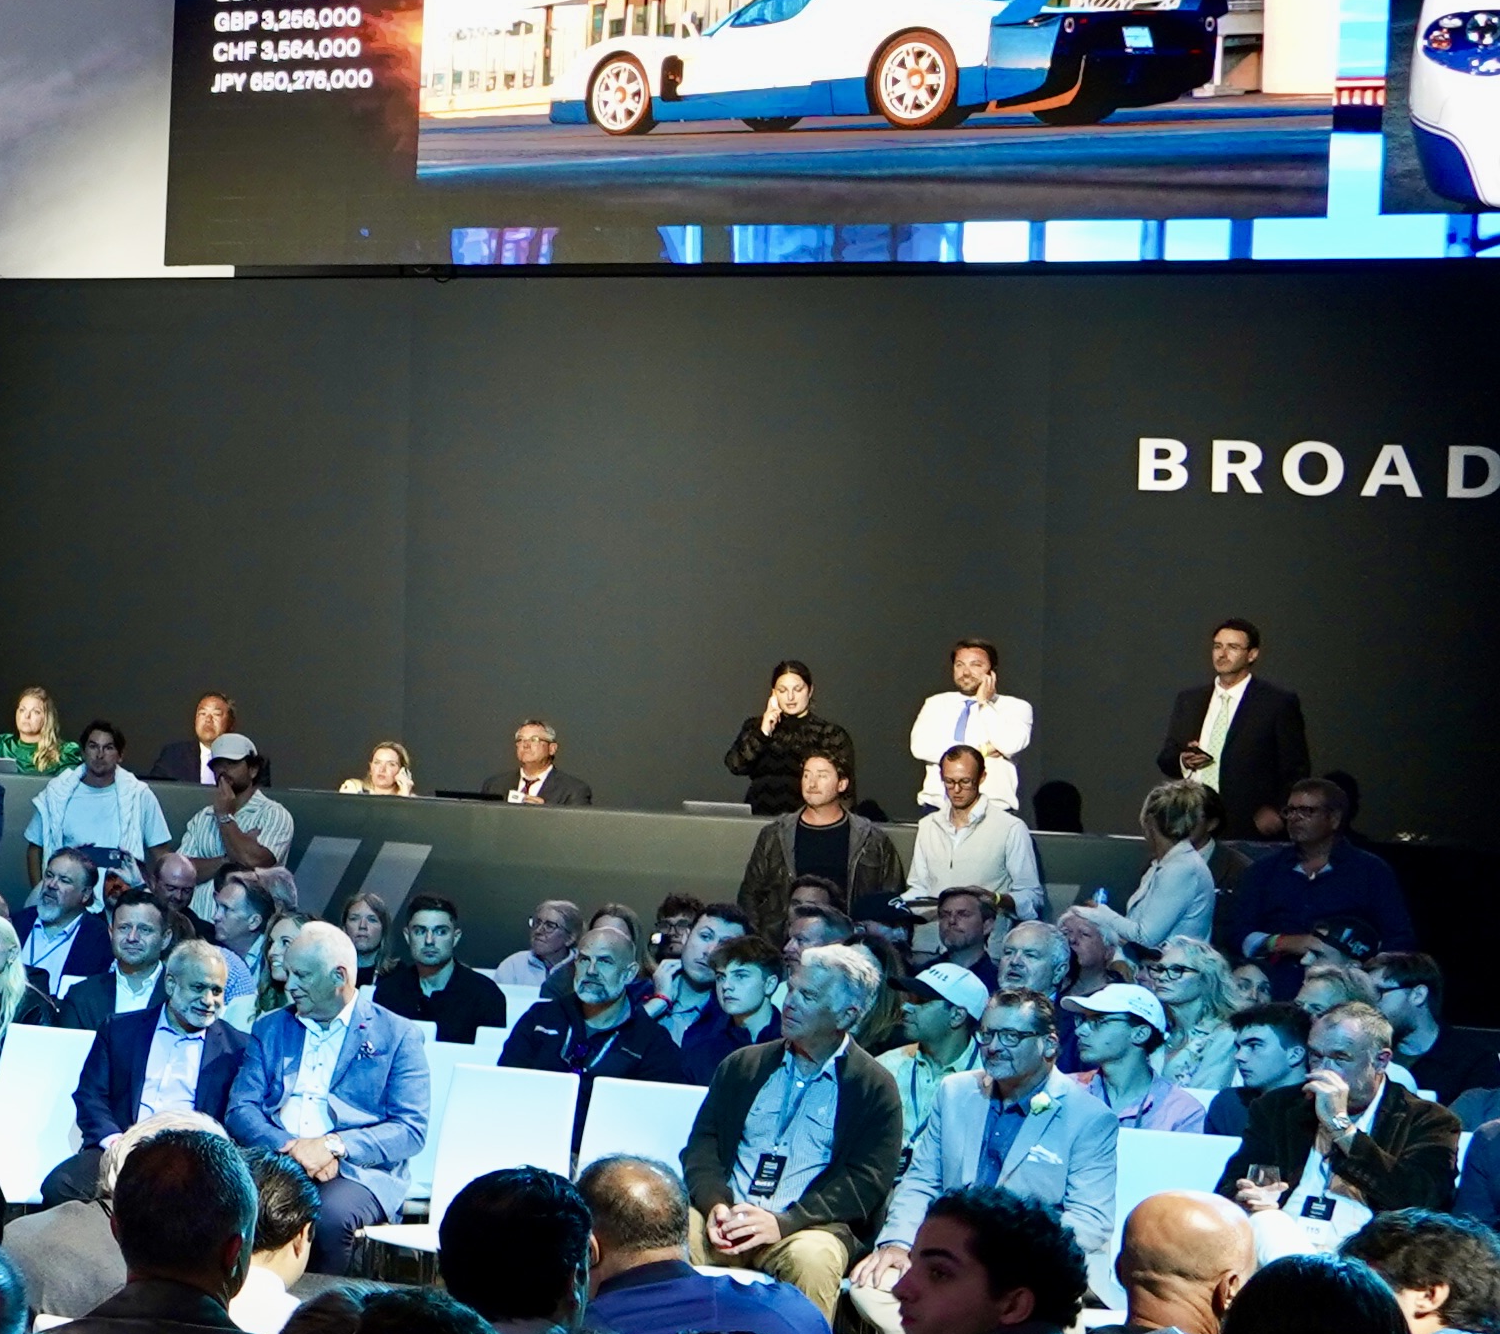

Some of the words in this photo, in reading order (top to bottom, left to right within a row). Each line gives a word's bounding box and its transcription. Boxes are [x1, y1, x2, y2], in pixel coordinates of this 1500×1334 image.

[213, 11, 258, 33] GBP
[260, 7, 362, 32] 3,256,000
[212, 40, 258, 63] CHF
[260, 37, 362, 63] 3,564,000
[210, 72, 248, 94] JPY
[1137, 437, 1500, 499] BROAD
